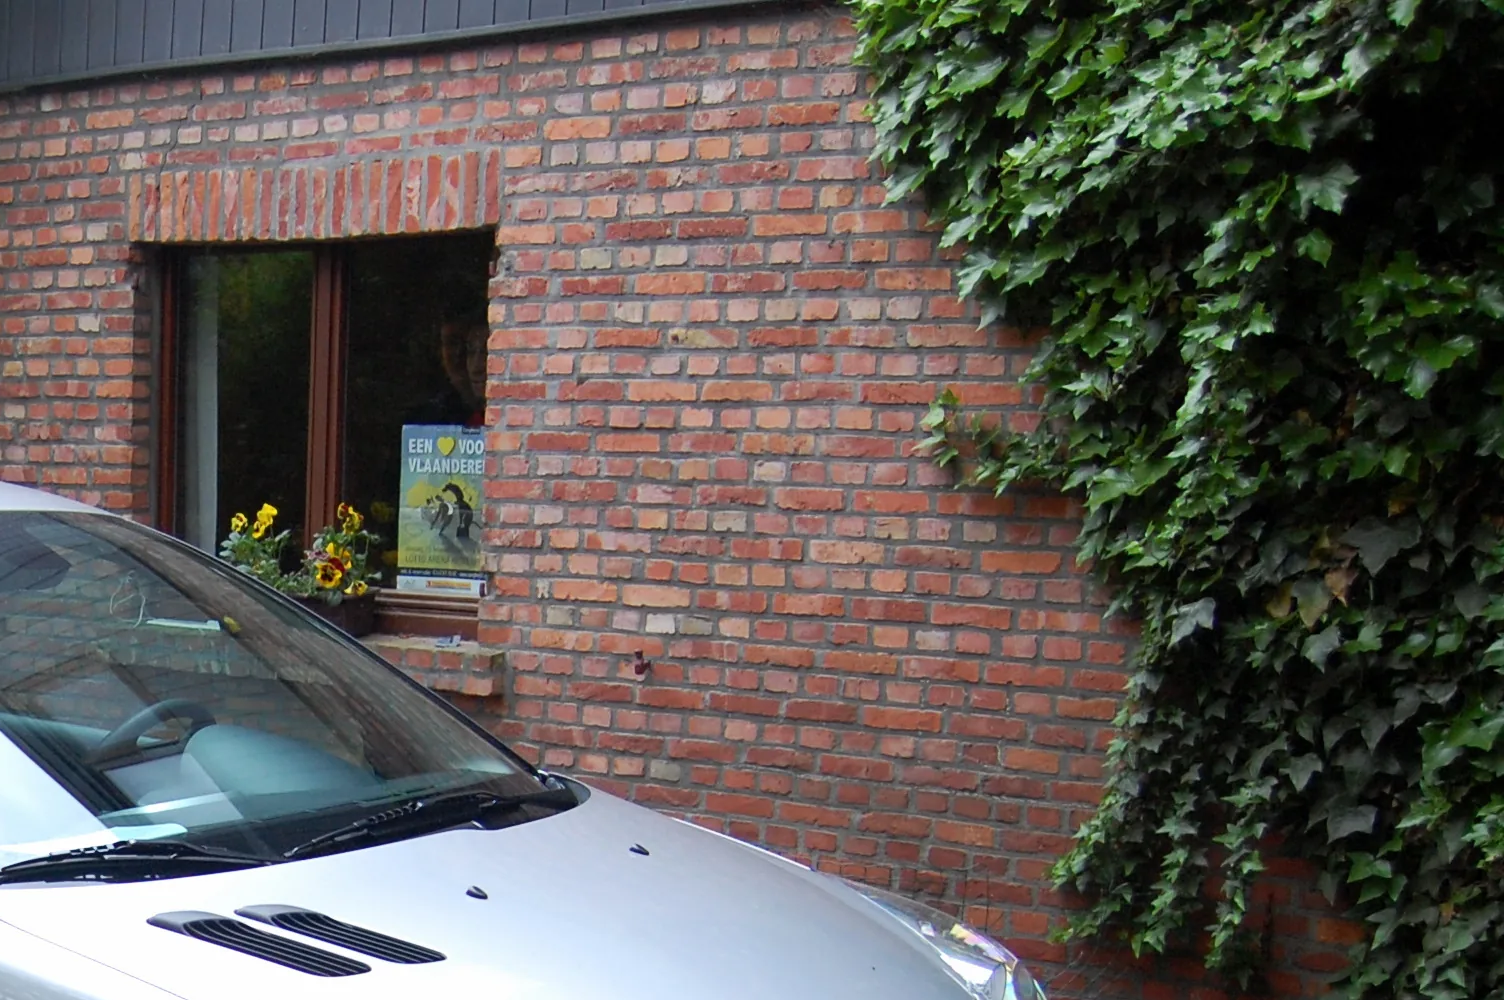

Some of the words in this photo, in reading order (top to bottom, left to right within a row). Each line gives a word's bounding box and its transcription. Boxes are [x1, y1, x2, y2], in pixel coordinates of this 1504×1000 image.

[408, 438, 433, 454] EEN
[458, 439, 485, 455] VOO
[408, 458, 485, 475] VLAANDERE
